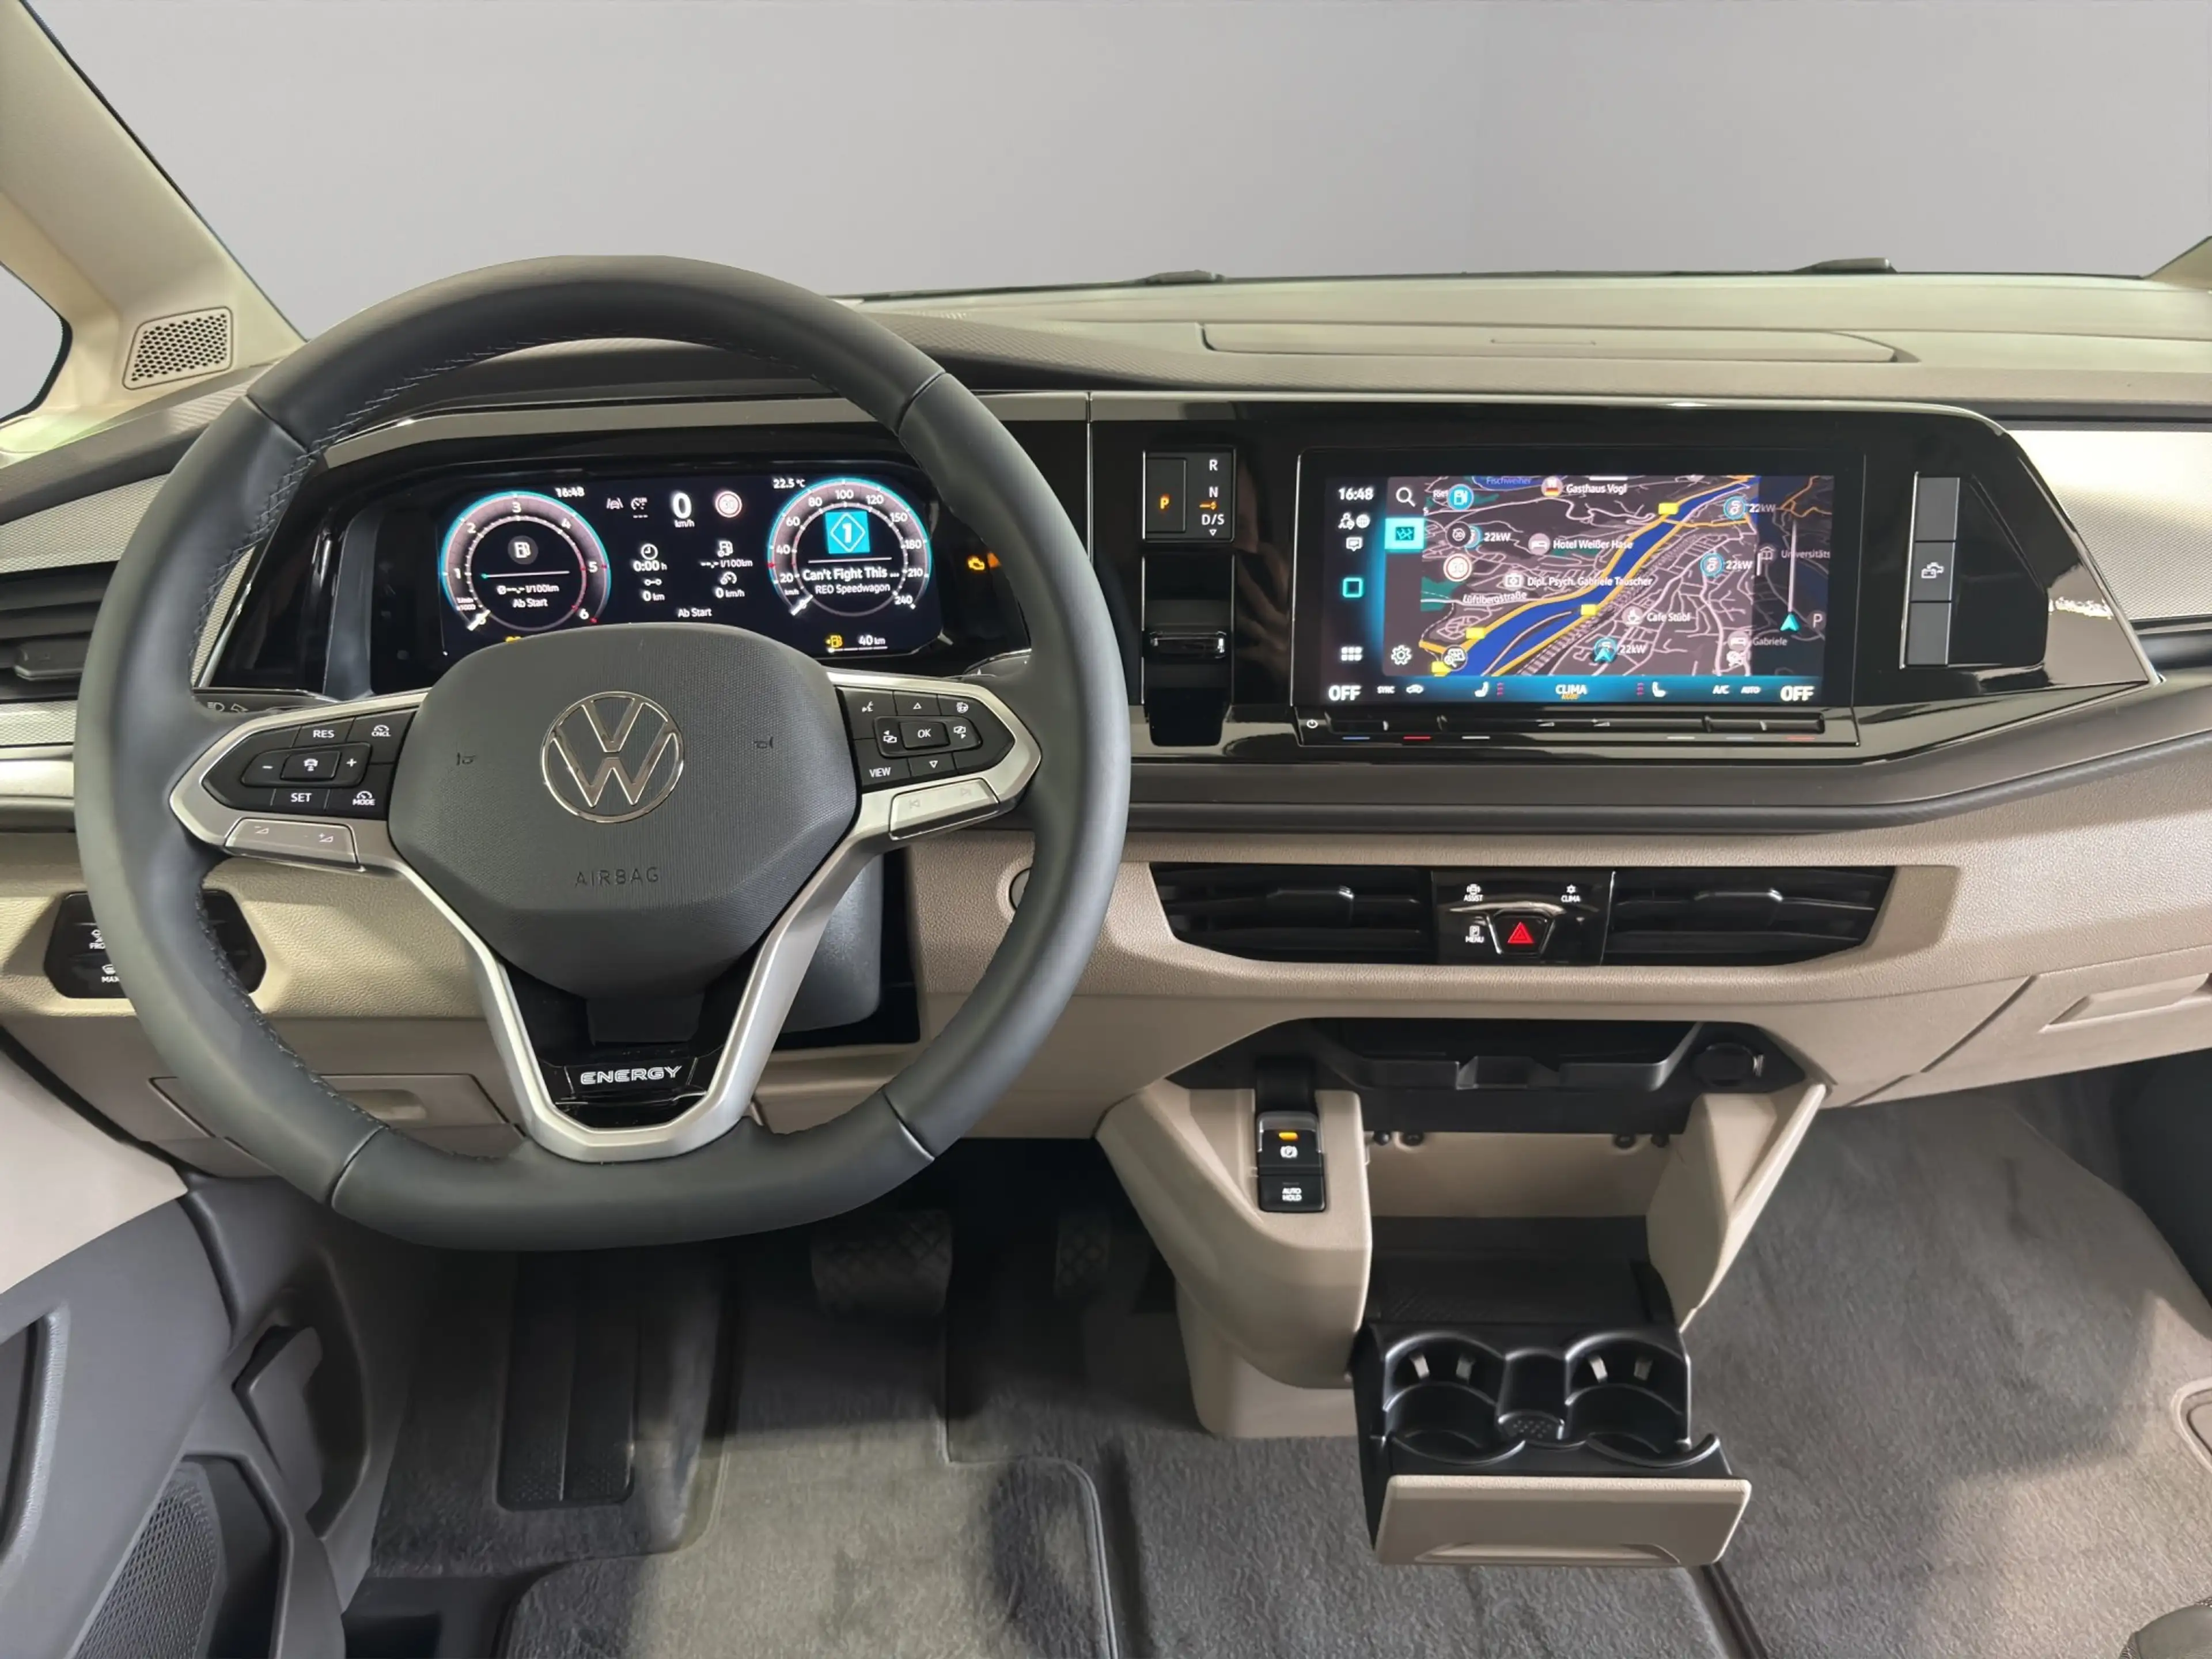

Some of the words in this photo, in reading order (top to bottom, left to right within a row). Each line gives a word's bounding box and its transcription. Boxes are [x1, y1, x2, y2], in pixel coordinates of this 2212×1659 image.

[1209, 459, 1218, 471] R
[772, 478, 795, 488] 22.5
[555, 486, 585, 498] 16:48
[835, 489, 854, 499] 100
[1209, 486, 1219, 498] N
[1338, 487, 1374, 501] 16:48
[1566, 484, 1606, 494] Gasthaus
[1607, 483, 1628, 495] Vogl
[808, 497, 823, 507] 80
[866, 494, 885, 505] 120
[1160, 496, 1169, 510] P
[512, 501, 522, 514] 3
[672, 492, 692, 519] 0
[1749, 503, 1776, 513] 22kW
[785, 516, 801, 527] 60
[890, 512, 908, 522] 150
[1202, 513, 1225, 525] D/S
[467, 522, 477, 534] 2
[560, 517, 572, 530] 4
[674, 520, 695, 528] km/h
[1483, 532, 1511, 542] 22kW
[776, 544, 791, 555] 40
[905, 539, 922, 550] 180
[1553, 539, 1577, 549] Hotel
[1578, 539, 1609, 550] Weißer
[1611, 539, 1634, 549] Hase
[1781, 550, 1831, 558] Unversitäts
[588, 561, 598, 573] 5
[632, 559, 660, 572] 0:00
[1726, 560, 1753, 570] 22kW
[453, 567, 462, 579] 1
[802, 568, 831, 581] Can't
[833, 567, 862, 582] Fight
[864, 566, 888, 578] This
[907, 567, 924, 578] 210
[780, 573, 794, 584] 20
[1527, 576, 1546, 588] Dipl.
[1548, 576, 1575, 588] Psych.
[1577, 576, 1613, 586] Gabriele
[1614, 576, 1652, 586] Tauscher
[715, 586, 724, 599] 0
[725, 589, 745, 598] km/h
[815, 584, 835, 594] REO
[836, 583, 891, 595] Speedwagon
[642, 589, 652, 602] 0
[652, 593, 665, 601] km
[894, 596, 914, 605] 240
[512, 599, 527, 608] Ab
[527, 597, 549, 608] Start
[578, 608, 590, 620] 6
[677, 609, 691, 618] Ab
[691, 607, 713, 618] Start
[858, 635, 873, 646] 40
[874, 637, 887, 645] km
[1752, 637, 1788, 646] Gabriele
[1619, 645, 1646, 654] 22kW
[1328, 684, 1363, 701] OFF
[1555, 684, 1588, 695] CLIMA
[1779, 685, 1816, 702] OFF
[312, 729, 335, 738] RES
[917, 729, 931, 739] OK
[869, 767, 892, 778] VIEW
[290, 792, 312, 803] SET
[352, 797, 376, 806] MODE
[576, 866, 660, 887] AIRBAG
[1463, 894, 1484, 902] ASSIST
[1560, 895, 1582, 903] CLIMA
[1465, 935, 1485, 944] MENU
[89, 942, 106, 950] FRO
[579, 1065, 683, 1085] ENERGY
[1282, 1187, 1302, 1195] AUTO
